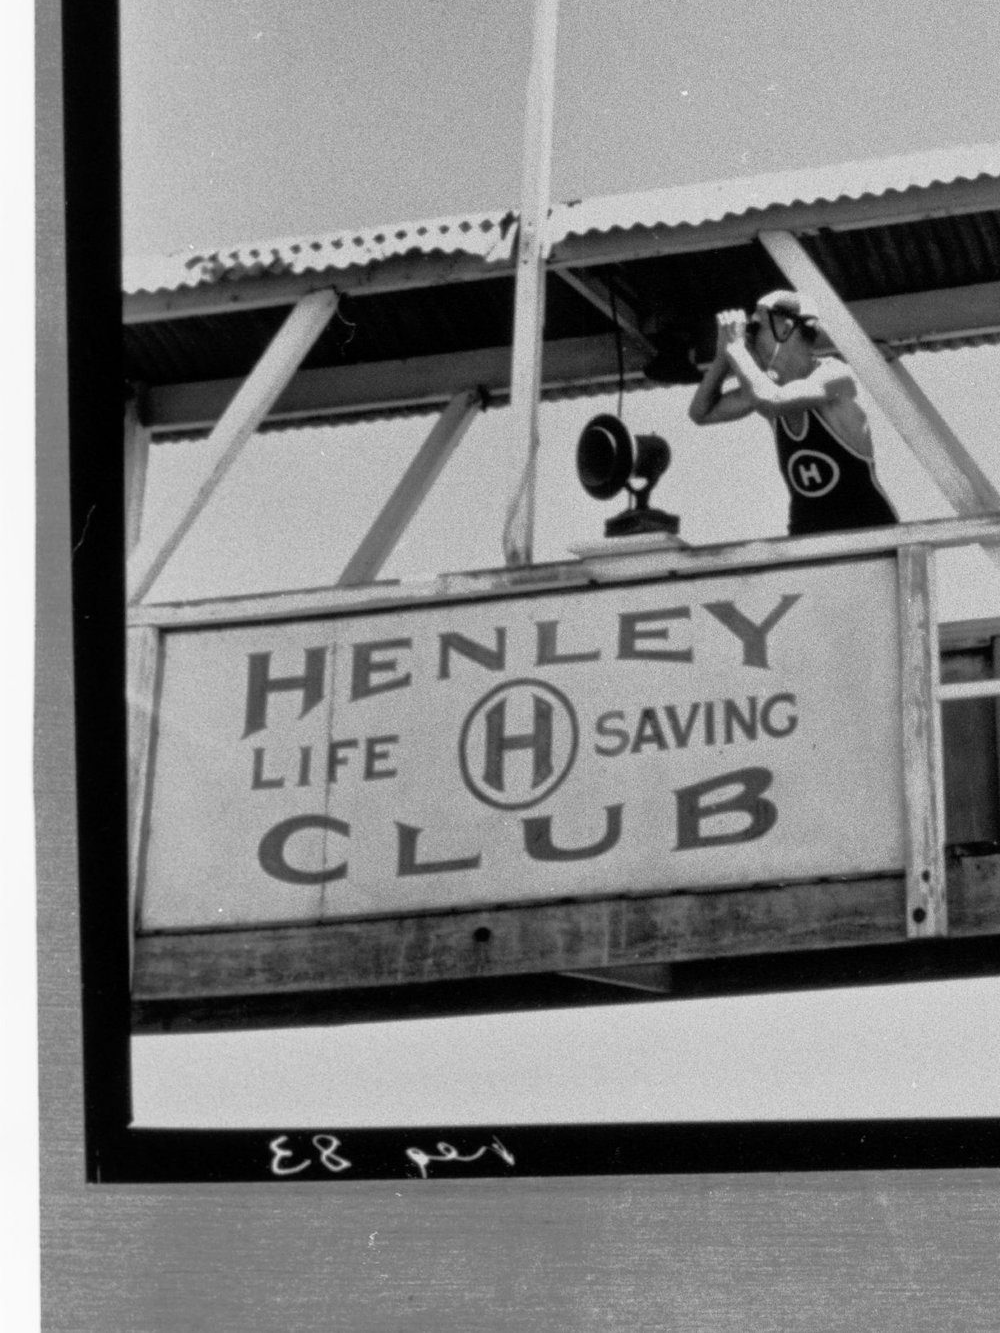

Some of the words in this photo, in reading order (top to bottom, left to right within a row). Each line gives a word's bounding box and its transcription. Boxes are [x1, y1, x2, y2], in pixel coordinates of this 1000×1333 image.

[799, 462, 822, 487] H
[240, 593, 803, 740] HENLEY
[250, 733, 400, 791] LIFE
[594, 692, 799, 757] SAVING
[482, 691, 554, 793] H
[256, 766, 779, 885] CLUB
